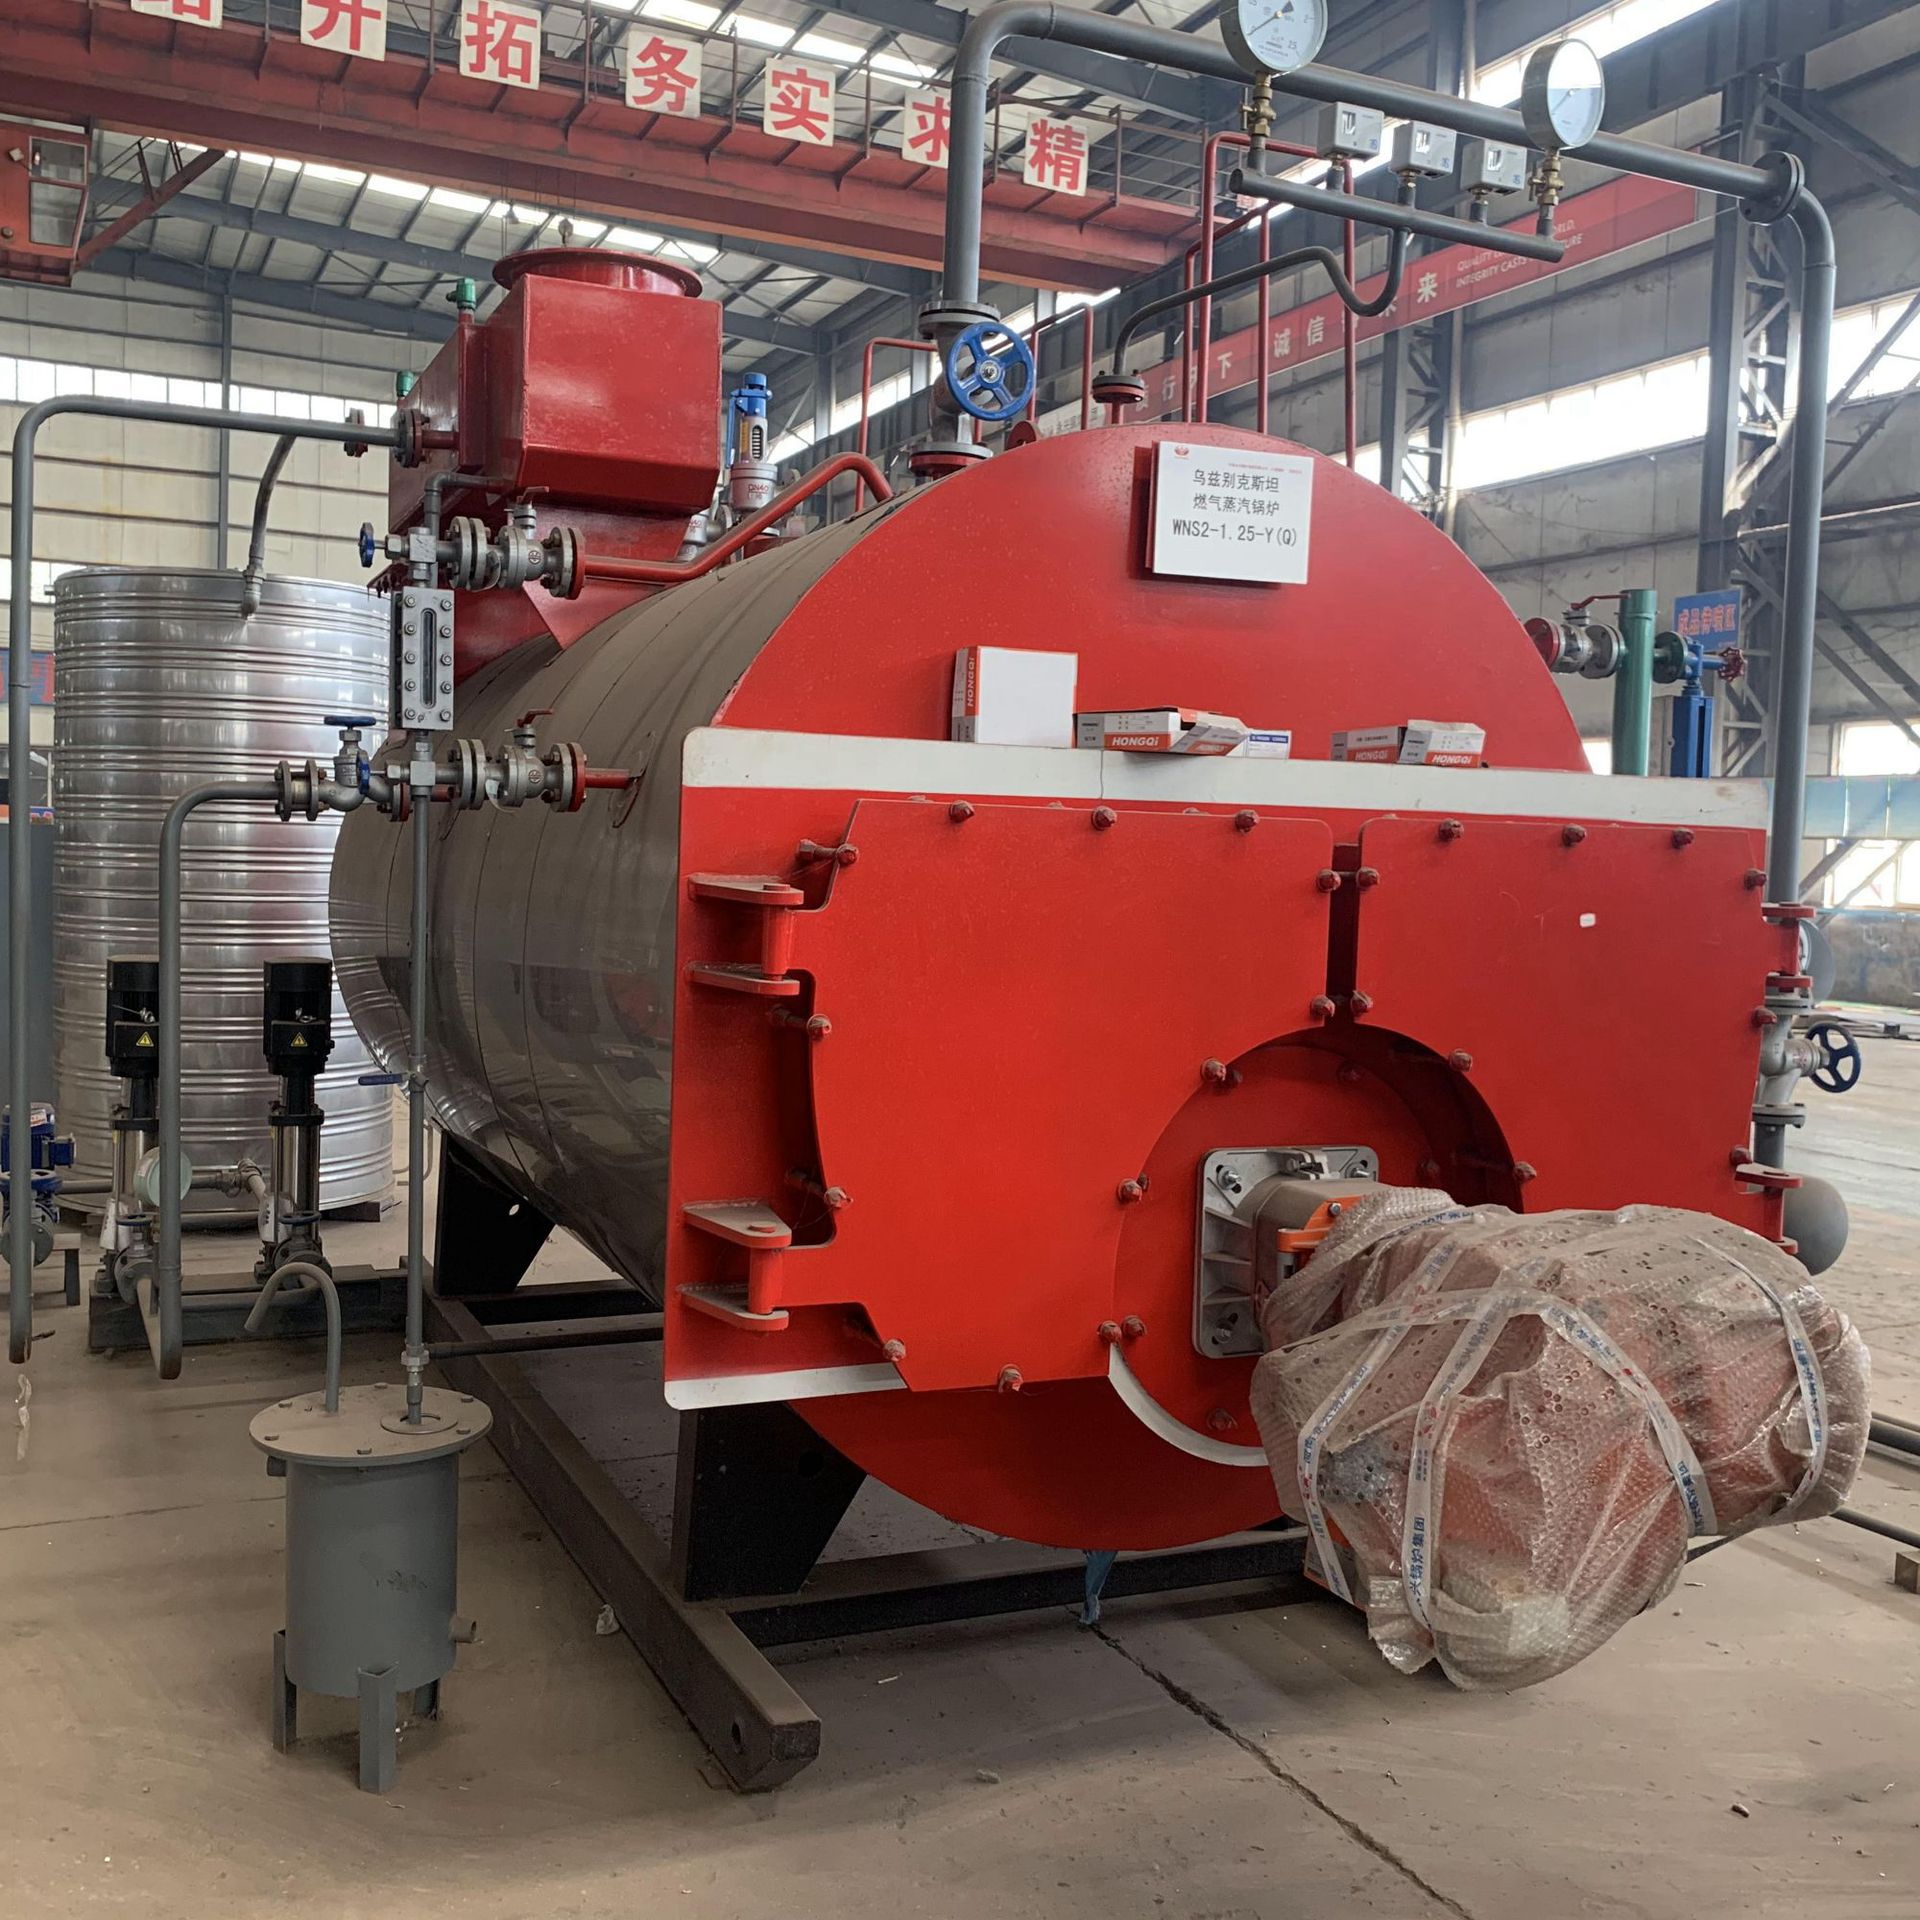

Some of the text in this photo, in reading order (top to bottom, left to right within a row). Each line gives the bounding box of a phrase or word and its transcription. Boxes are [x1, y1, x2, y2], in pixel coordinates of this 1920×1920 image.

[466, 1, 538, 85] 拓
[632, 36, 697, 113] 务
[769, 67, 830, 141] 实
[1029, 118, 1088, 191] 精
[1457, 251, 1492, 271] QUALITY
[1456, 264, 1500, 288] INTEGRITY
[1193, 468, 1279, 493] 乌兹别克斯坦
[1193, 493, 1280, 517] 燃气蒸汽锅炉
[1172, 518, 1298, 548] WNS2-1.25-Y(Q)
